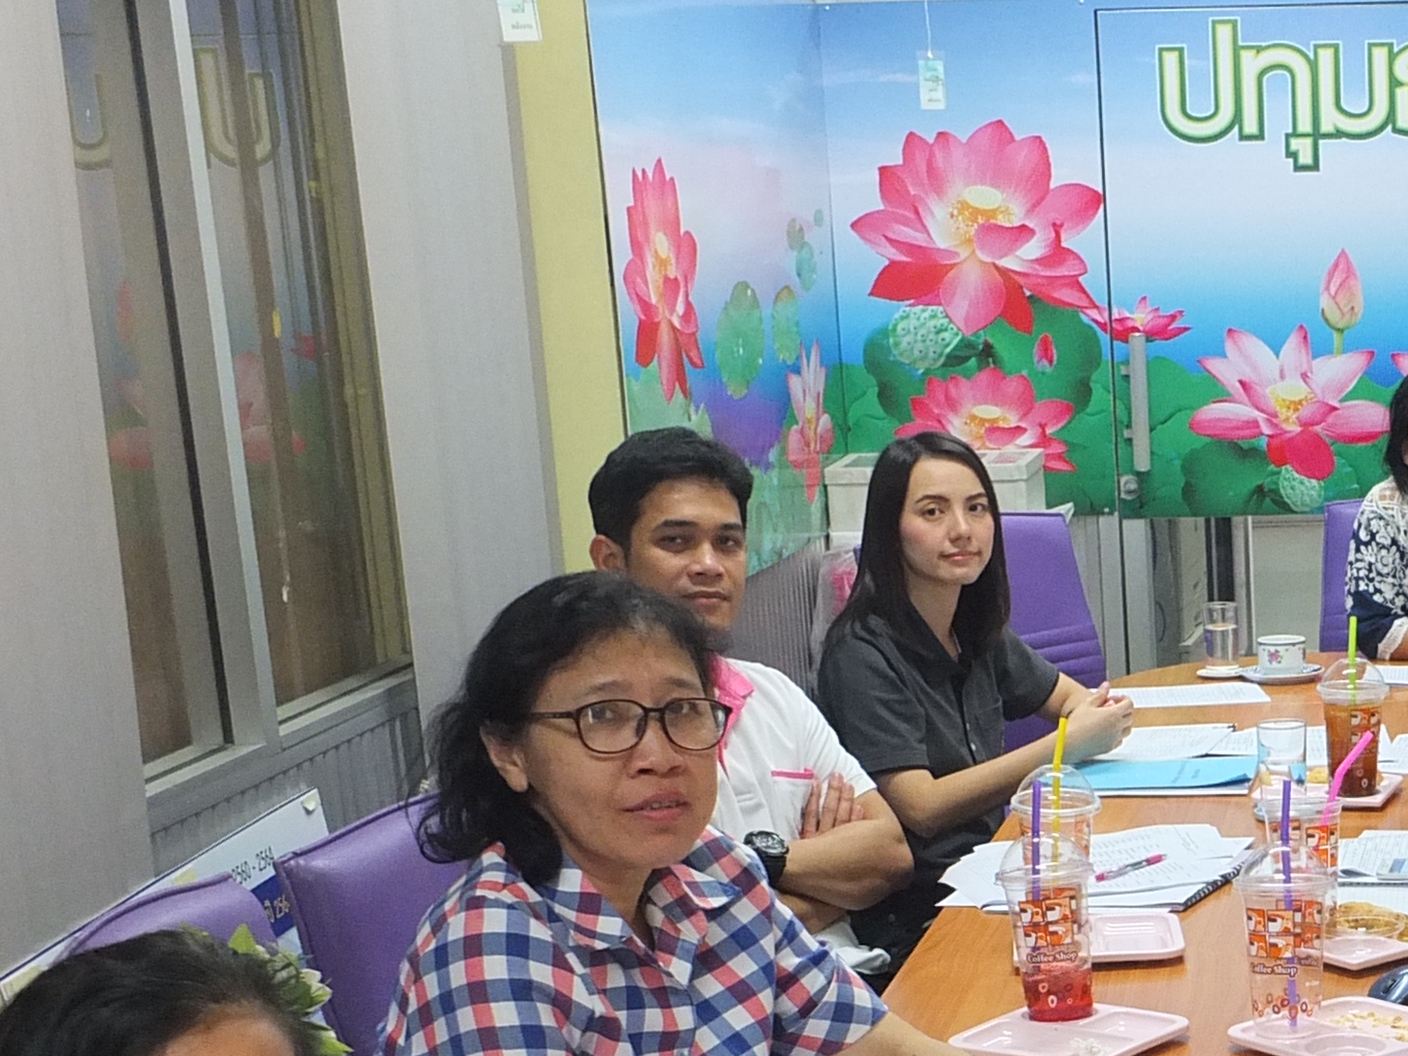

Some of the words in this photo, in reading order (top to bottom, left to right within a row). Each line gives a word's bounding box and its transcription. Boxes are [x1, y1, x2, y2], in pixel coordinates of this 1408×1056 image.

[1028, 952, 1054, 963] Coffee
[1055, 951, 1077, 962] Shop
[1273, 965, 1298, 978] Shop
